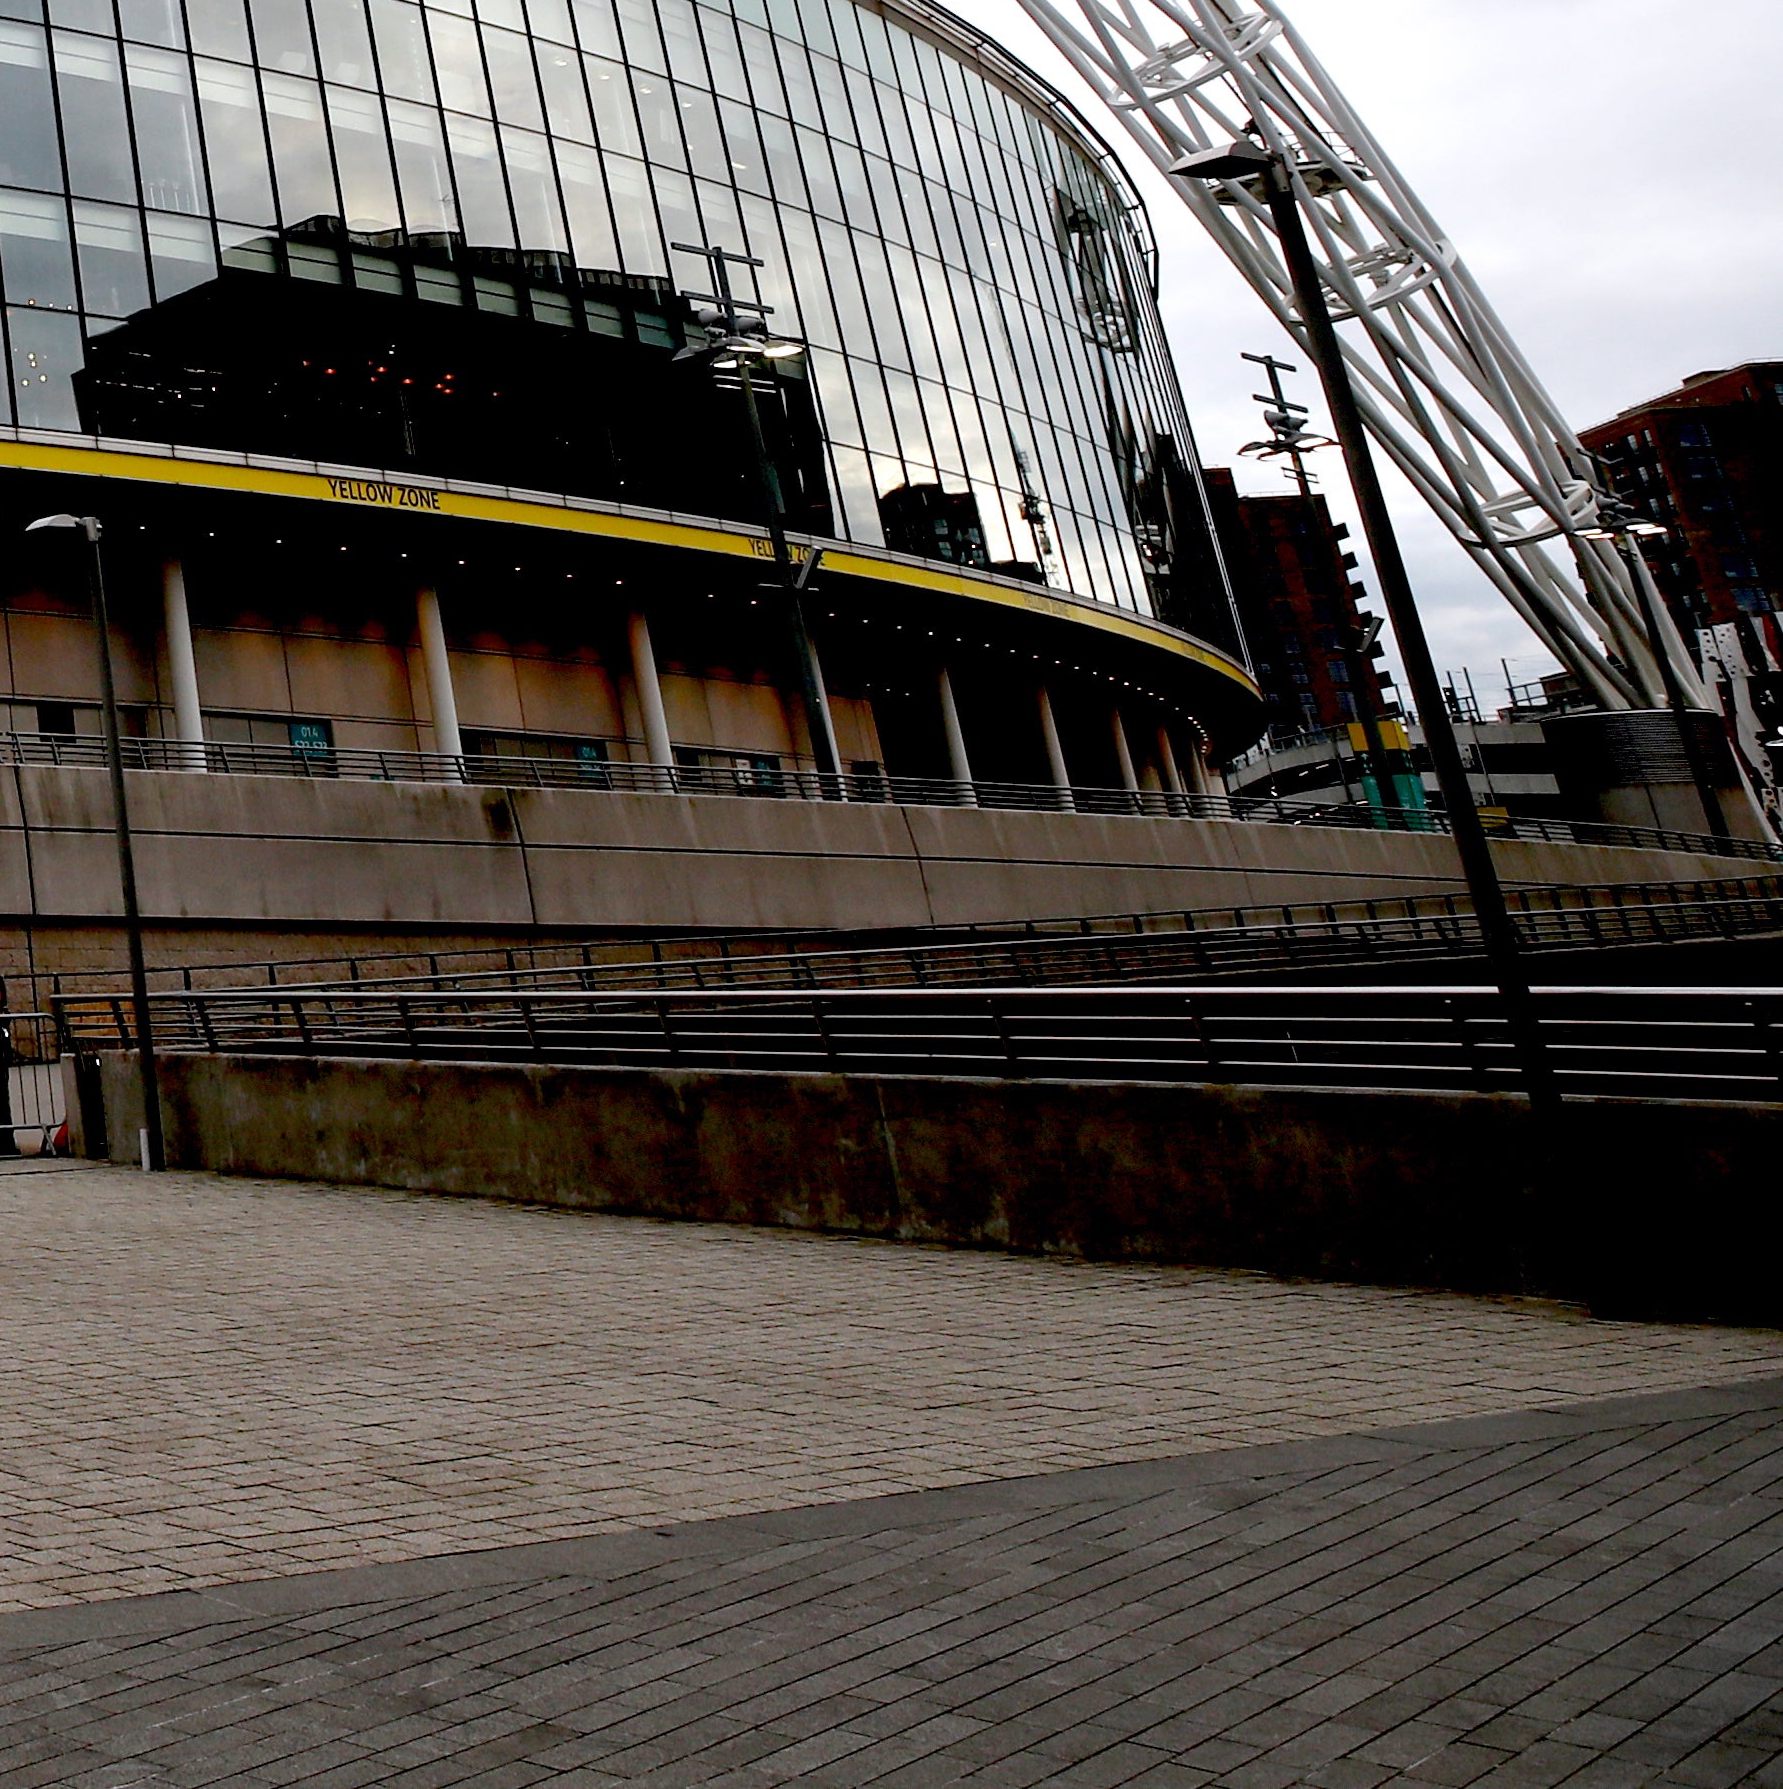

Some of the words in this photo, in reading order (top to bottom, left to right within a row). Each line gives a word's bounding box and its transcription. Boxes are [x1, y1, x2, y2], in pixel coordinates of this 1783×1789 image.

[328, 479, 393, 504] YELLOW
[397, 488, 440, 510] ZONE
[748, 538, 793, 560] YELL
